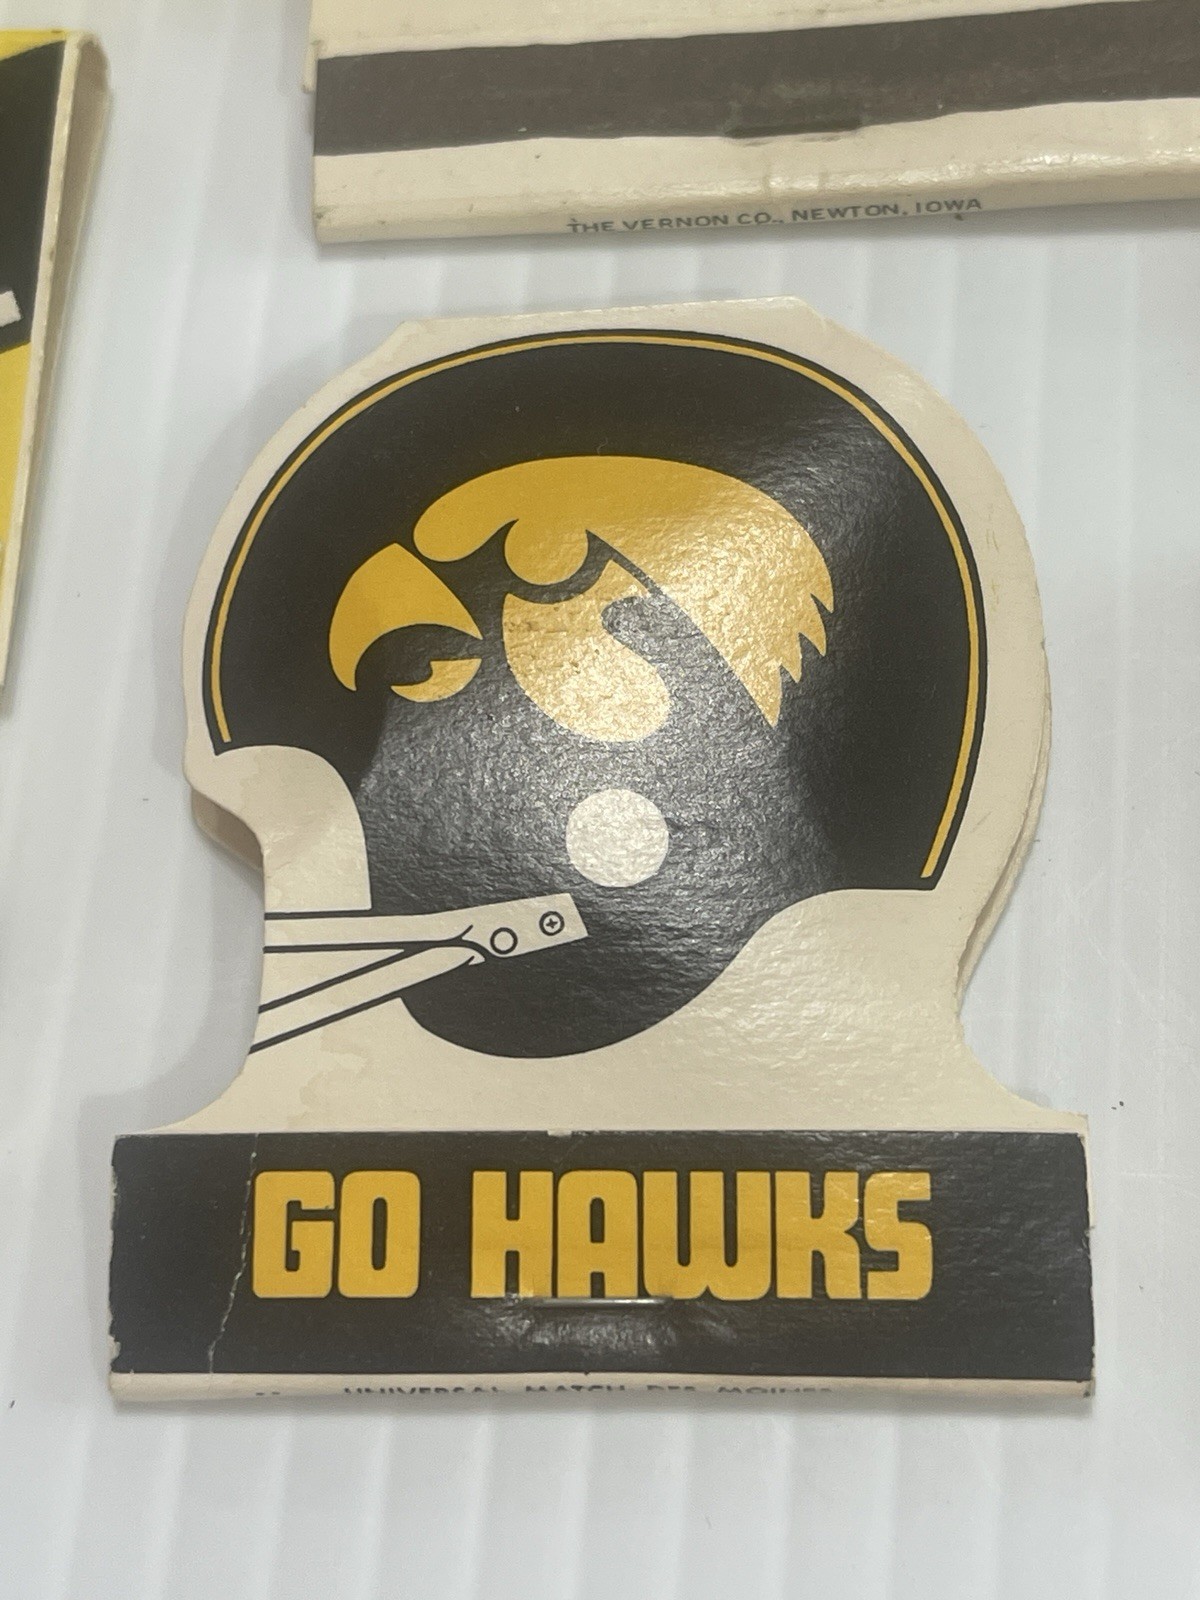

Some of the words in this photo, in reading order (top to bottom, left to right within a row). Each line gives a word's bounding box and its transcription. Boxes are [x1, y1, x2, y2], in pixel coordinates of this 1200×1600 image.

[567, 219, 614, 233] THE
[622, 214, 729, 230] VERNON
[915, 198, 982, 213] IOWA
[252, 1170, 421, 1299] GO
[470, 1170, 933, 1301] HAWKS
